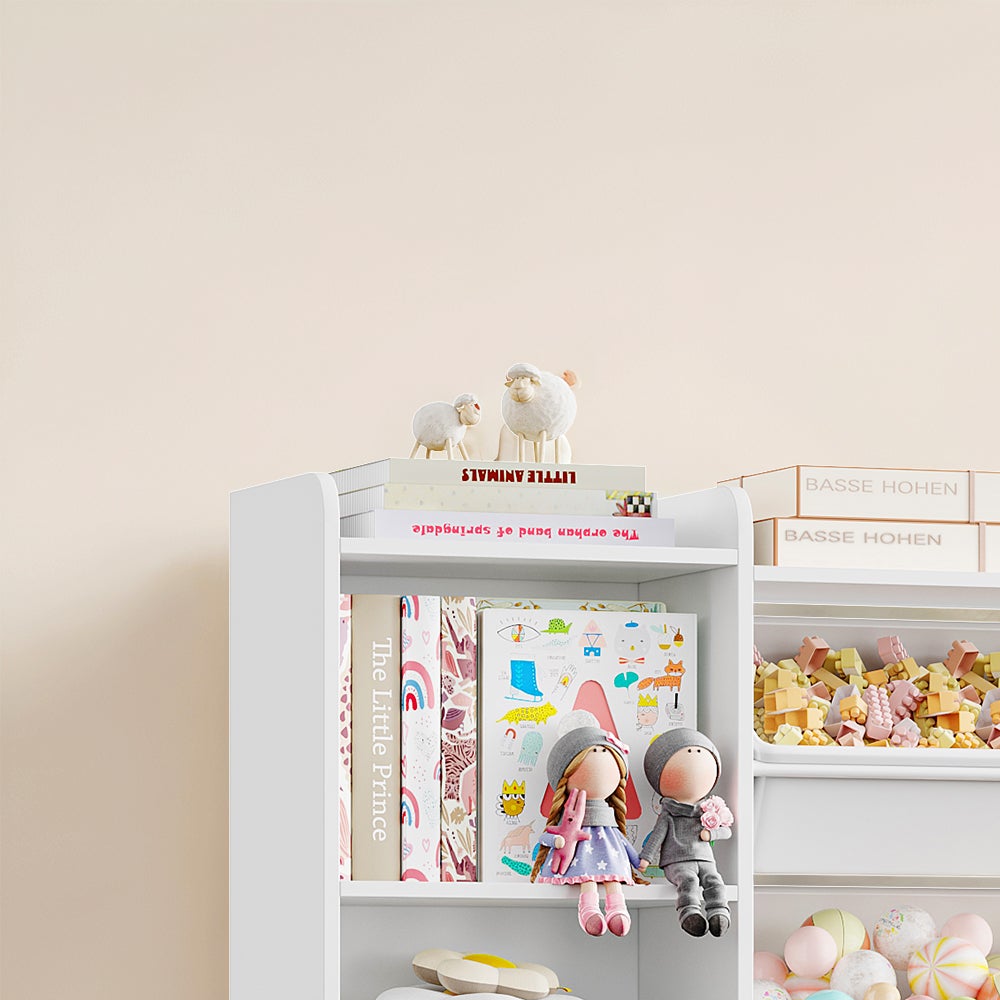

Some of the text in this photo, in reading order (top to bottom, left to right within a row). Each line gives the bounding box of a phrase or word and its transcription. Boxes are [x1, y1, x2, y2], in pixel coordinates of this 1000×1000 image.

[460, 468, 577, 484] LITTLE ANIMALS
[805, 477, 958, 496] BASSE HOHEN
[411, 523, 640, 541] The orphan band of springdale
[784, 529, 942, 546] BASSE HOHEN
[371, 637, 393, 842] The Little Prince
